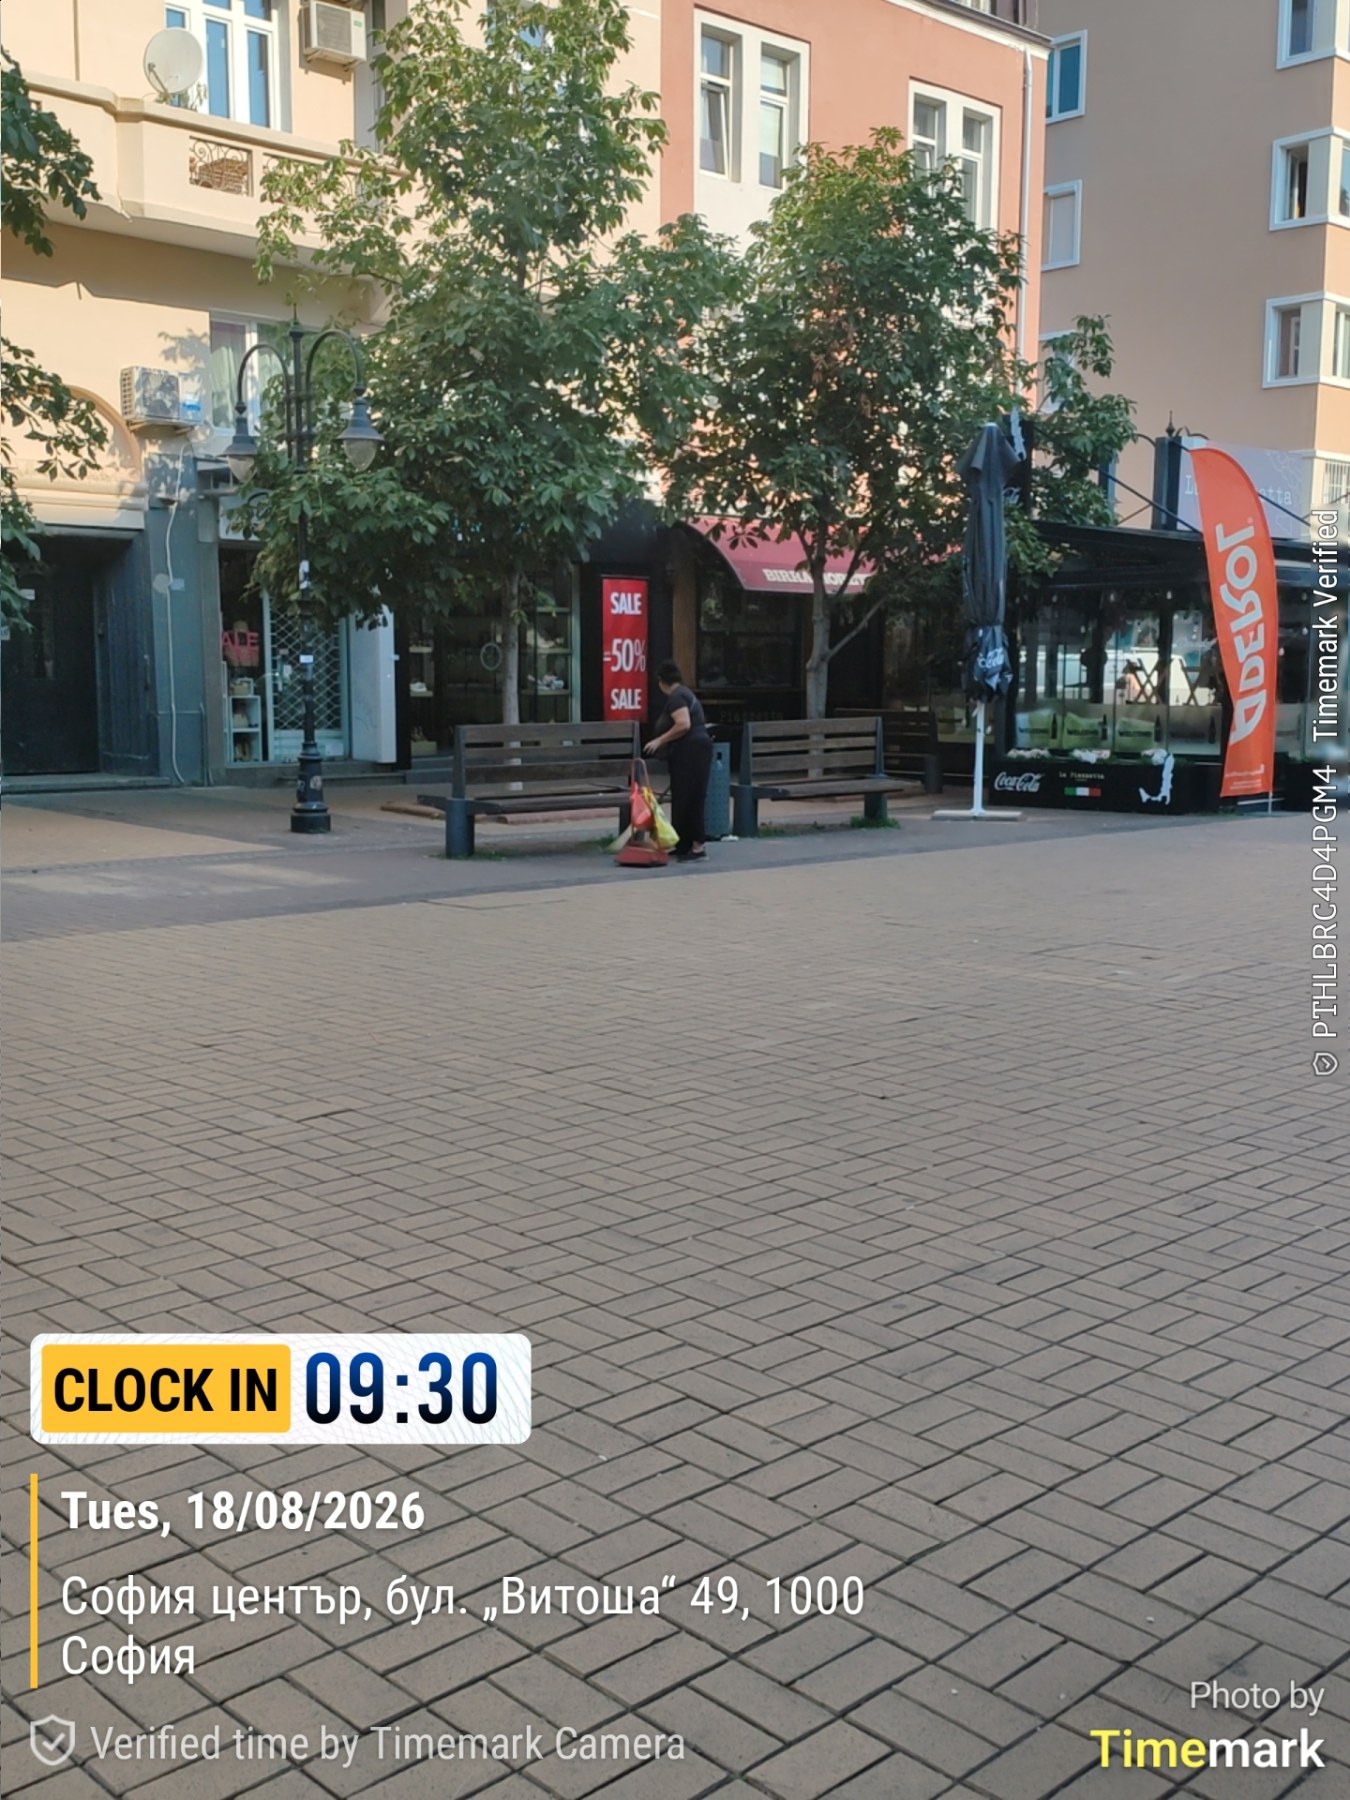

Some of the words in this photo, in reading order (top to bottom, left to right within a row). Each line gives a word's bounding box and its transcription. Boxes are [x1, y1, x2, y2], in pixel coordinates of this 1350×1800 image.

[610, 592, 642, 615] SALE
[222, 631, 259, 650] ALE
[610, 688, 642, 710] SALE
